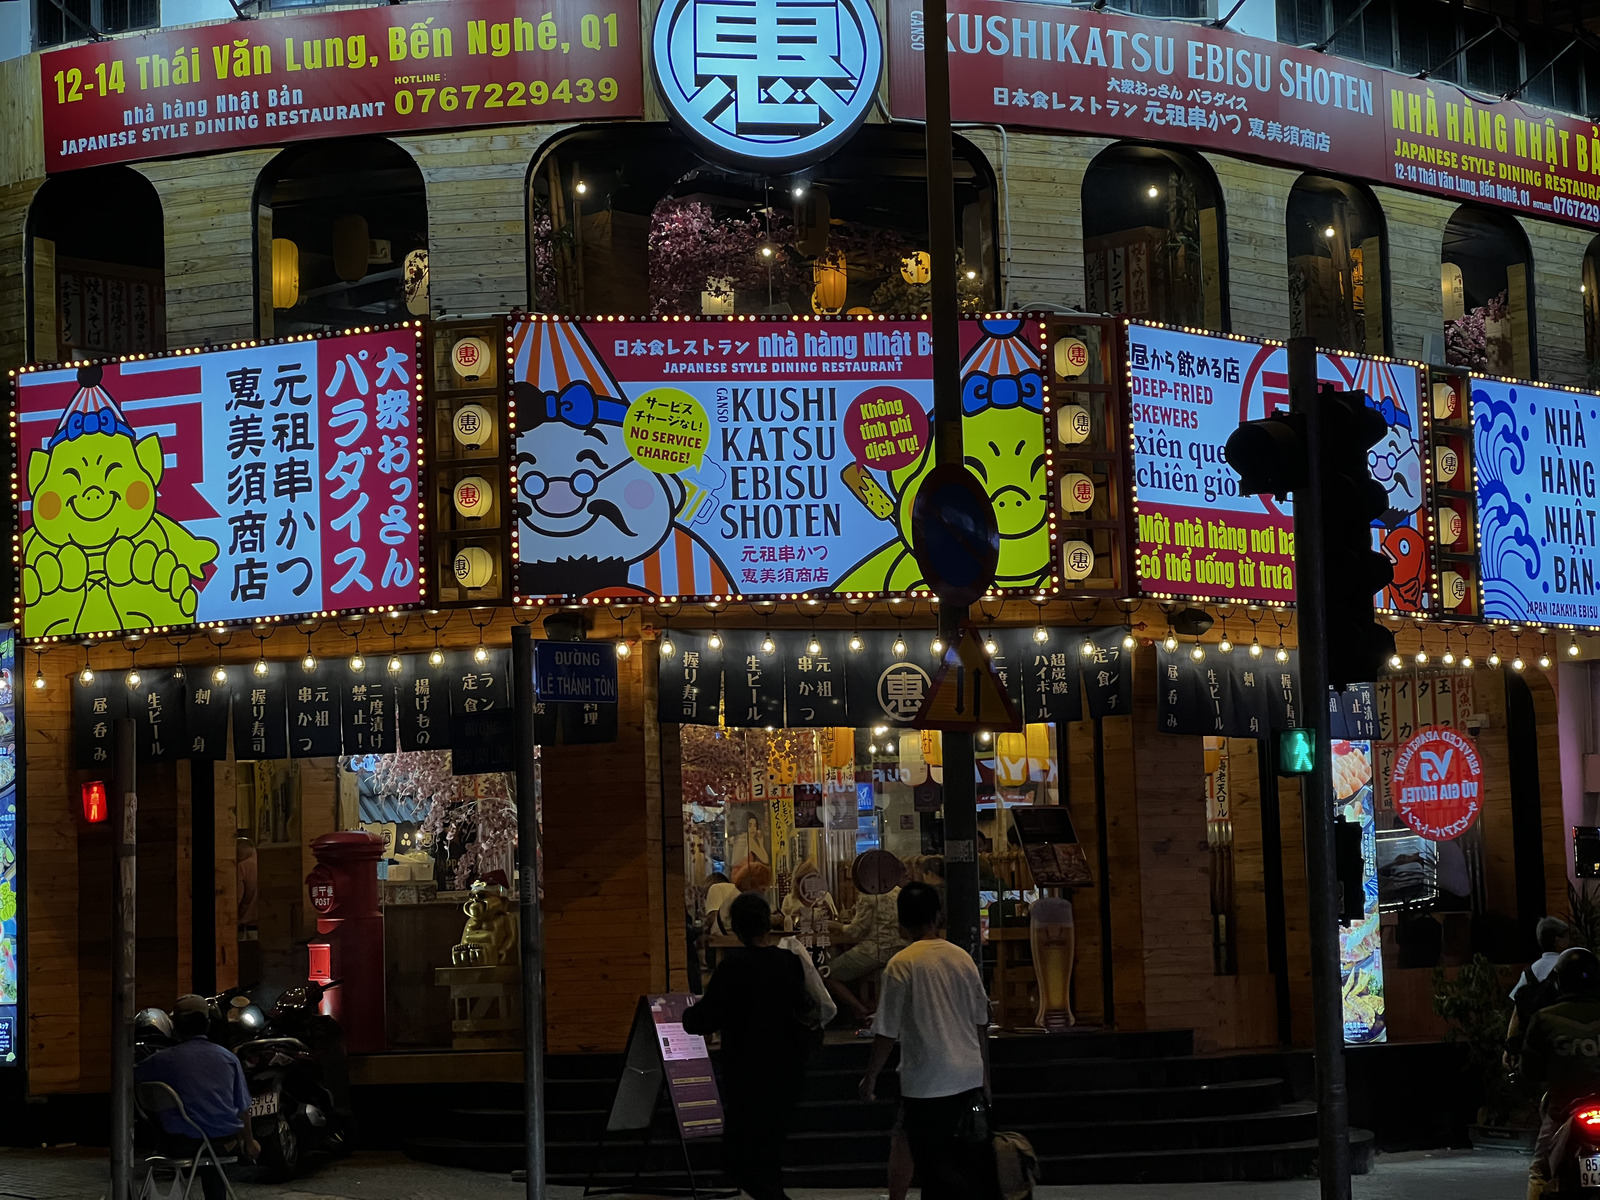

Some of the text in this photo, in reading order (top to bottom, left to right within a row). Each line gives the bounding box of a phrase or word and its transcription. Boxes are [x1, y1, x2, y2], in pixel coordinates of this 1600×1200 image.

[54, 12, 619, 104] 12-14 Thái Văn Lung, Bến Nghé, Q1
[1186, 40, 1272, 93] EBISU
[1279, 58, 1374, 116] SHOTEN
[123, 84, 304, 126] nhà hàng Nhật Bản
[394, 77, 619, 115] 0767229439
[993, 86, 1139, 118] 日本食レストラン
[1143, 100, 1242, 135] 元祖串かつ
[1107, 77, 1249, 112] 大衆おっさん パラダイス
[60, 101, 386, 156] JAPANESE STYLE DINING RESTAURANT
[1390, 87, 1440, 138] NHÀ
[1445, 96, 1508, 154] HÀNG
[1514, 117, 1570, 173] NHẬT
[1394, 138, 1459, 169] JAPANESE
[1461, 154, 1496, 177] STYLE
[1498, 163, 1542, 188] DINING
[1394, 162, 1417, 183] 12-14
[1418, 166, 1437, 186] Thái
[1437, 170, 1454, 190] Văn
[1456, 175, 1479, 198] Lung,
[1479, 179, 1496, 200] Bến
[1521, 190, 1531, 207] Q1
[614, 338, 750, 356] 日本食レストラン
[663, 360, 904, 374] JAPANESE STYLE DINING RESTAURANT
[758, 330, 799, 358] nhà
[804, 330, 858, 359] hàng
[863, 330, 912, 362] Nhật
[1131, 342, 1241, 384] 昼から飲める店
[645, 396, 694, 416] サービス
[716, 387, 729, 423] GANSO
[731, 387, 838, 422] KUSHI
[860, 398, 904, 420] Không
[1132, 375, 1214, 405] DEEP-FRIED
[633, 410, 703, 432] チャージなし!
[860, 414, 912, 440] tính phí
[1133, 403, 1199, 429] SKEWERS
[1544, 399, 1587, 449] NHÀ
[630, 426, 703, 449] NO SERVICE
[636, 445, 691, 465] CHARGE!
[721, 426, 836, 461] KATSU
[865, 434, 920, 461] dịch vụ!
[1135, 427, 1183, 460] xiên
[270, 362, 315, 597] 元祖串かつ
[324, 349, 374, 594] パラダイス
[376, 346, 414, 588] 大衆おっさん
[730, 465, 828, 500] EBISU
[1136, 461, 1252, 502] chiên giò
[1540, 446, 1596, 499] HÀNG
[720, 503, 841, 539] SHOTEN
[1138, 512, 1295, 561] Một nhà hàng nơi bạ
[1544, 498, 1597, 556] NHẬT
[740, 544, 829, 564] 元祖串かつ
[1140, 547, 1294, 590] có thể uống từ trưa
[1553, 545, 1595, 596] BẢN
[1526, 600, 1598, 620] JAPAN IZAKAYA EBISU
[555, 648, 600, 666] ĐƯỜNG
[816, 656, 833, 698] 元祖
[1051, 652, 1068, 695] 超炭酸
[478, 672, 496, 712] ラン
[541, 672, 615, 697] LÊ THÁNH TÔN
[681, 651, 699, 719] 握り寿司
[746, 655, 763, 722] 生ビール
[798, 656, 815, 719] 串かつ
[1036, 654, 1052, 719] ハイボール
[1167, 664, 1178, 728] 昼呑み
[1207, 668, 1224, 731] 生ビール
[1243, 671, 1259, 732] 刺身
[147, 692, 165, 756] 生ビール
[191, 687, 211, 753] 刺身
[250, 688, 267, 753] 握り寿司
[297, 686, 314, 752] 串かつ
[314, 686, 329, 727] 元祖
[352, 683, 367, 749] 禁止！
[369, 683, 385, 750] 二度漬け
[414, 678, 431, 745] 揚げもの
[92, 696, 108, 762] 昼呑み
[315, 898, 331, 906] POST
[1555, 1035, 1600, 1057] Gra
